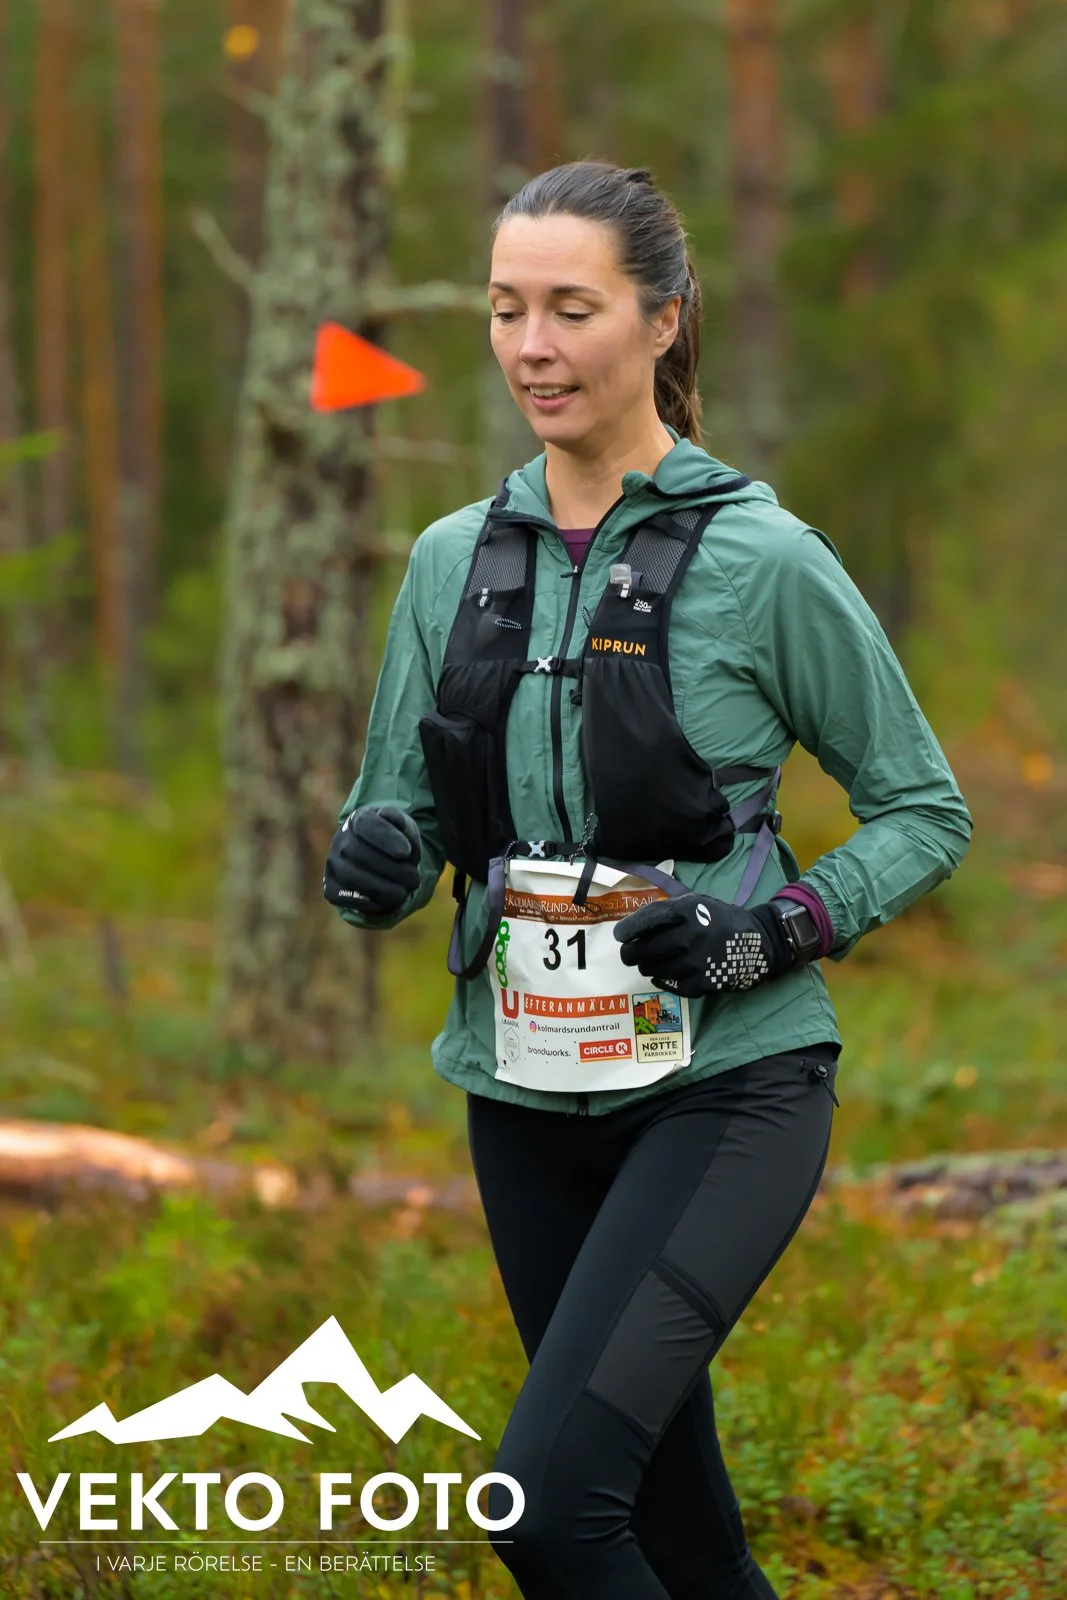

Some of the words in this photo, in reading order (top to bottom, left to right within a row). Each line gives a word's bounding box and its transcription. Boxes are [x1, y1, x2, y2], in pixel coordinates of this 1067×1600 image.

[592, 637, 646, 656] KIPRUN
[495, 920, 510, 989] coop
[543, 928, 586, 971] 31
[525, 997, 627, 1013] EFTERANMÄLAN
[537, 1022, 620, 1034] kolmardsrundantrail
[583, 1045, 614, 1056] CIRCLE
[617, 1043, 627, 1054] K
[642, 1041, 678, 1051] NØTTE
